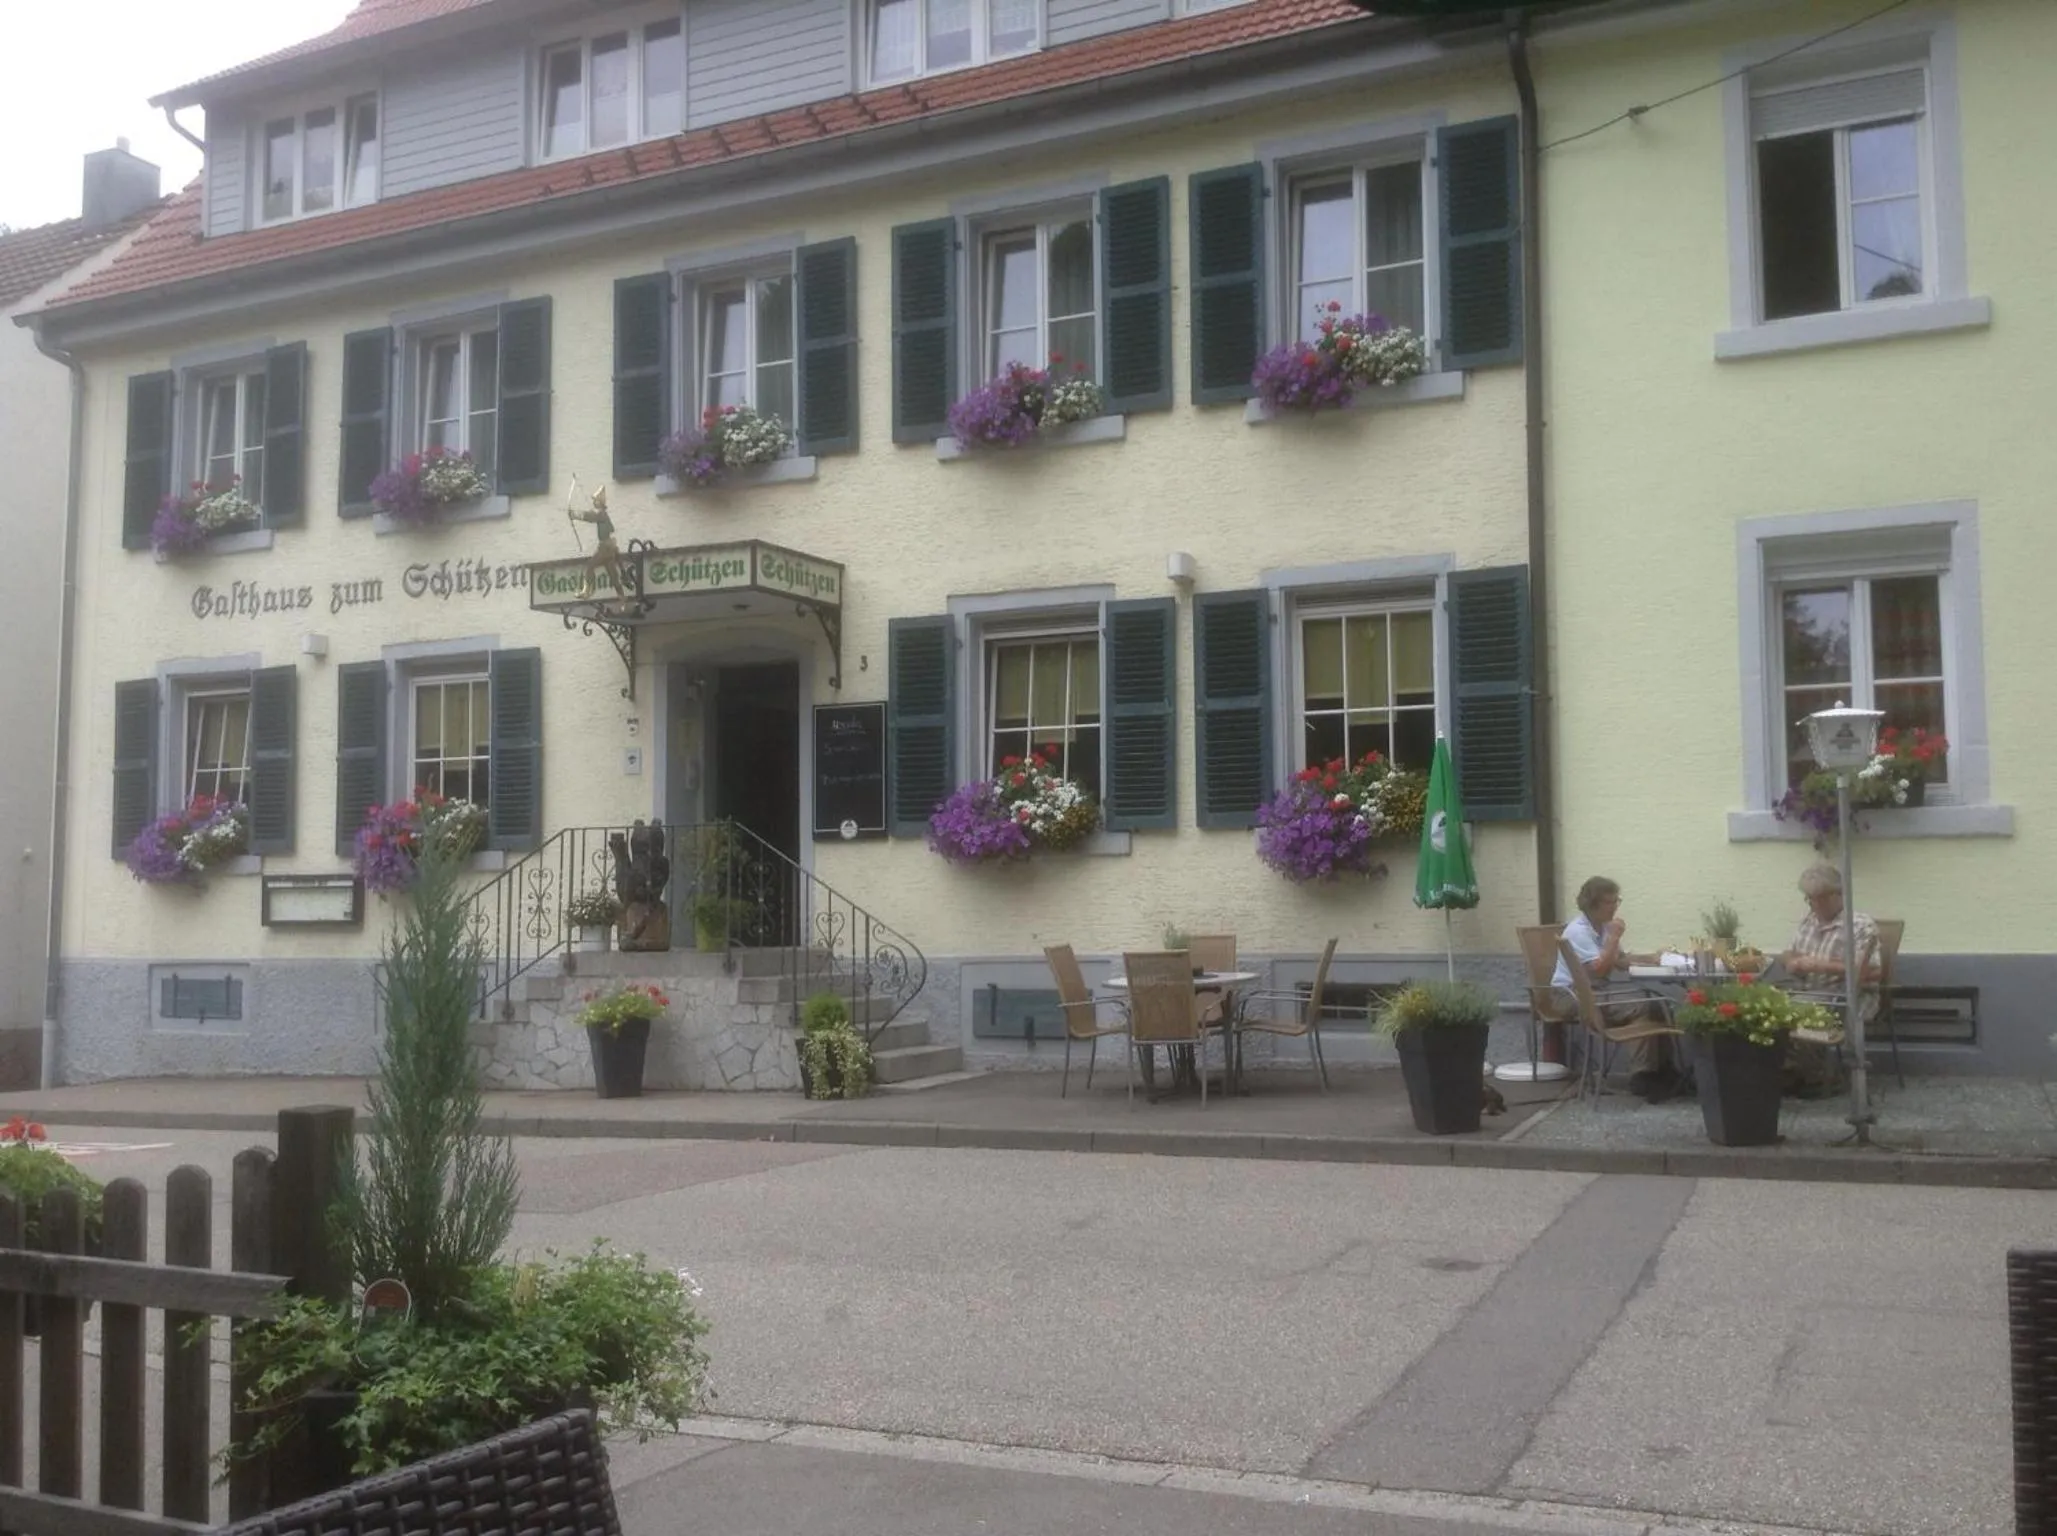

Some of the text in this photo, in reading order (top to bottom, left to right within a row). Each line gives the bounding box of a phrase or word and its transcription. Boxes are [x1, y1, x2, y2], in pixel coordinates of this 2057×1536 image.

[330, 577, 384, 614] zum
[402, 556, 527, 599] Schützen
[537, 557, 746, 595] Gasta Schützen
[761, 553, 835, 596] Schützen
